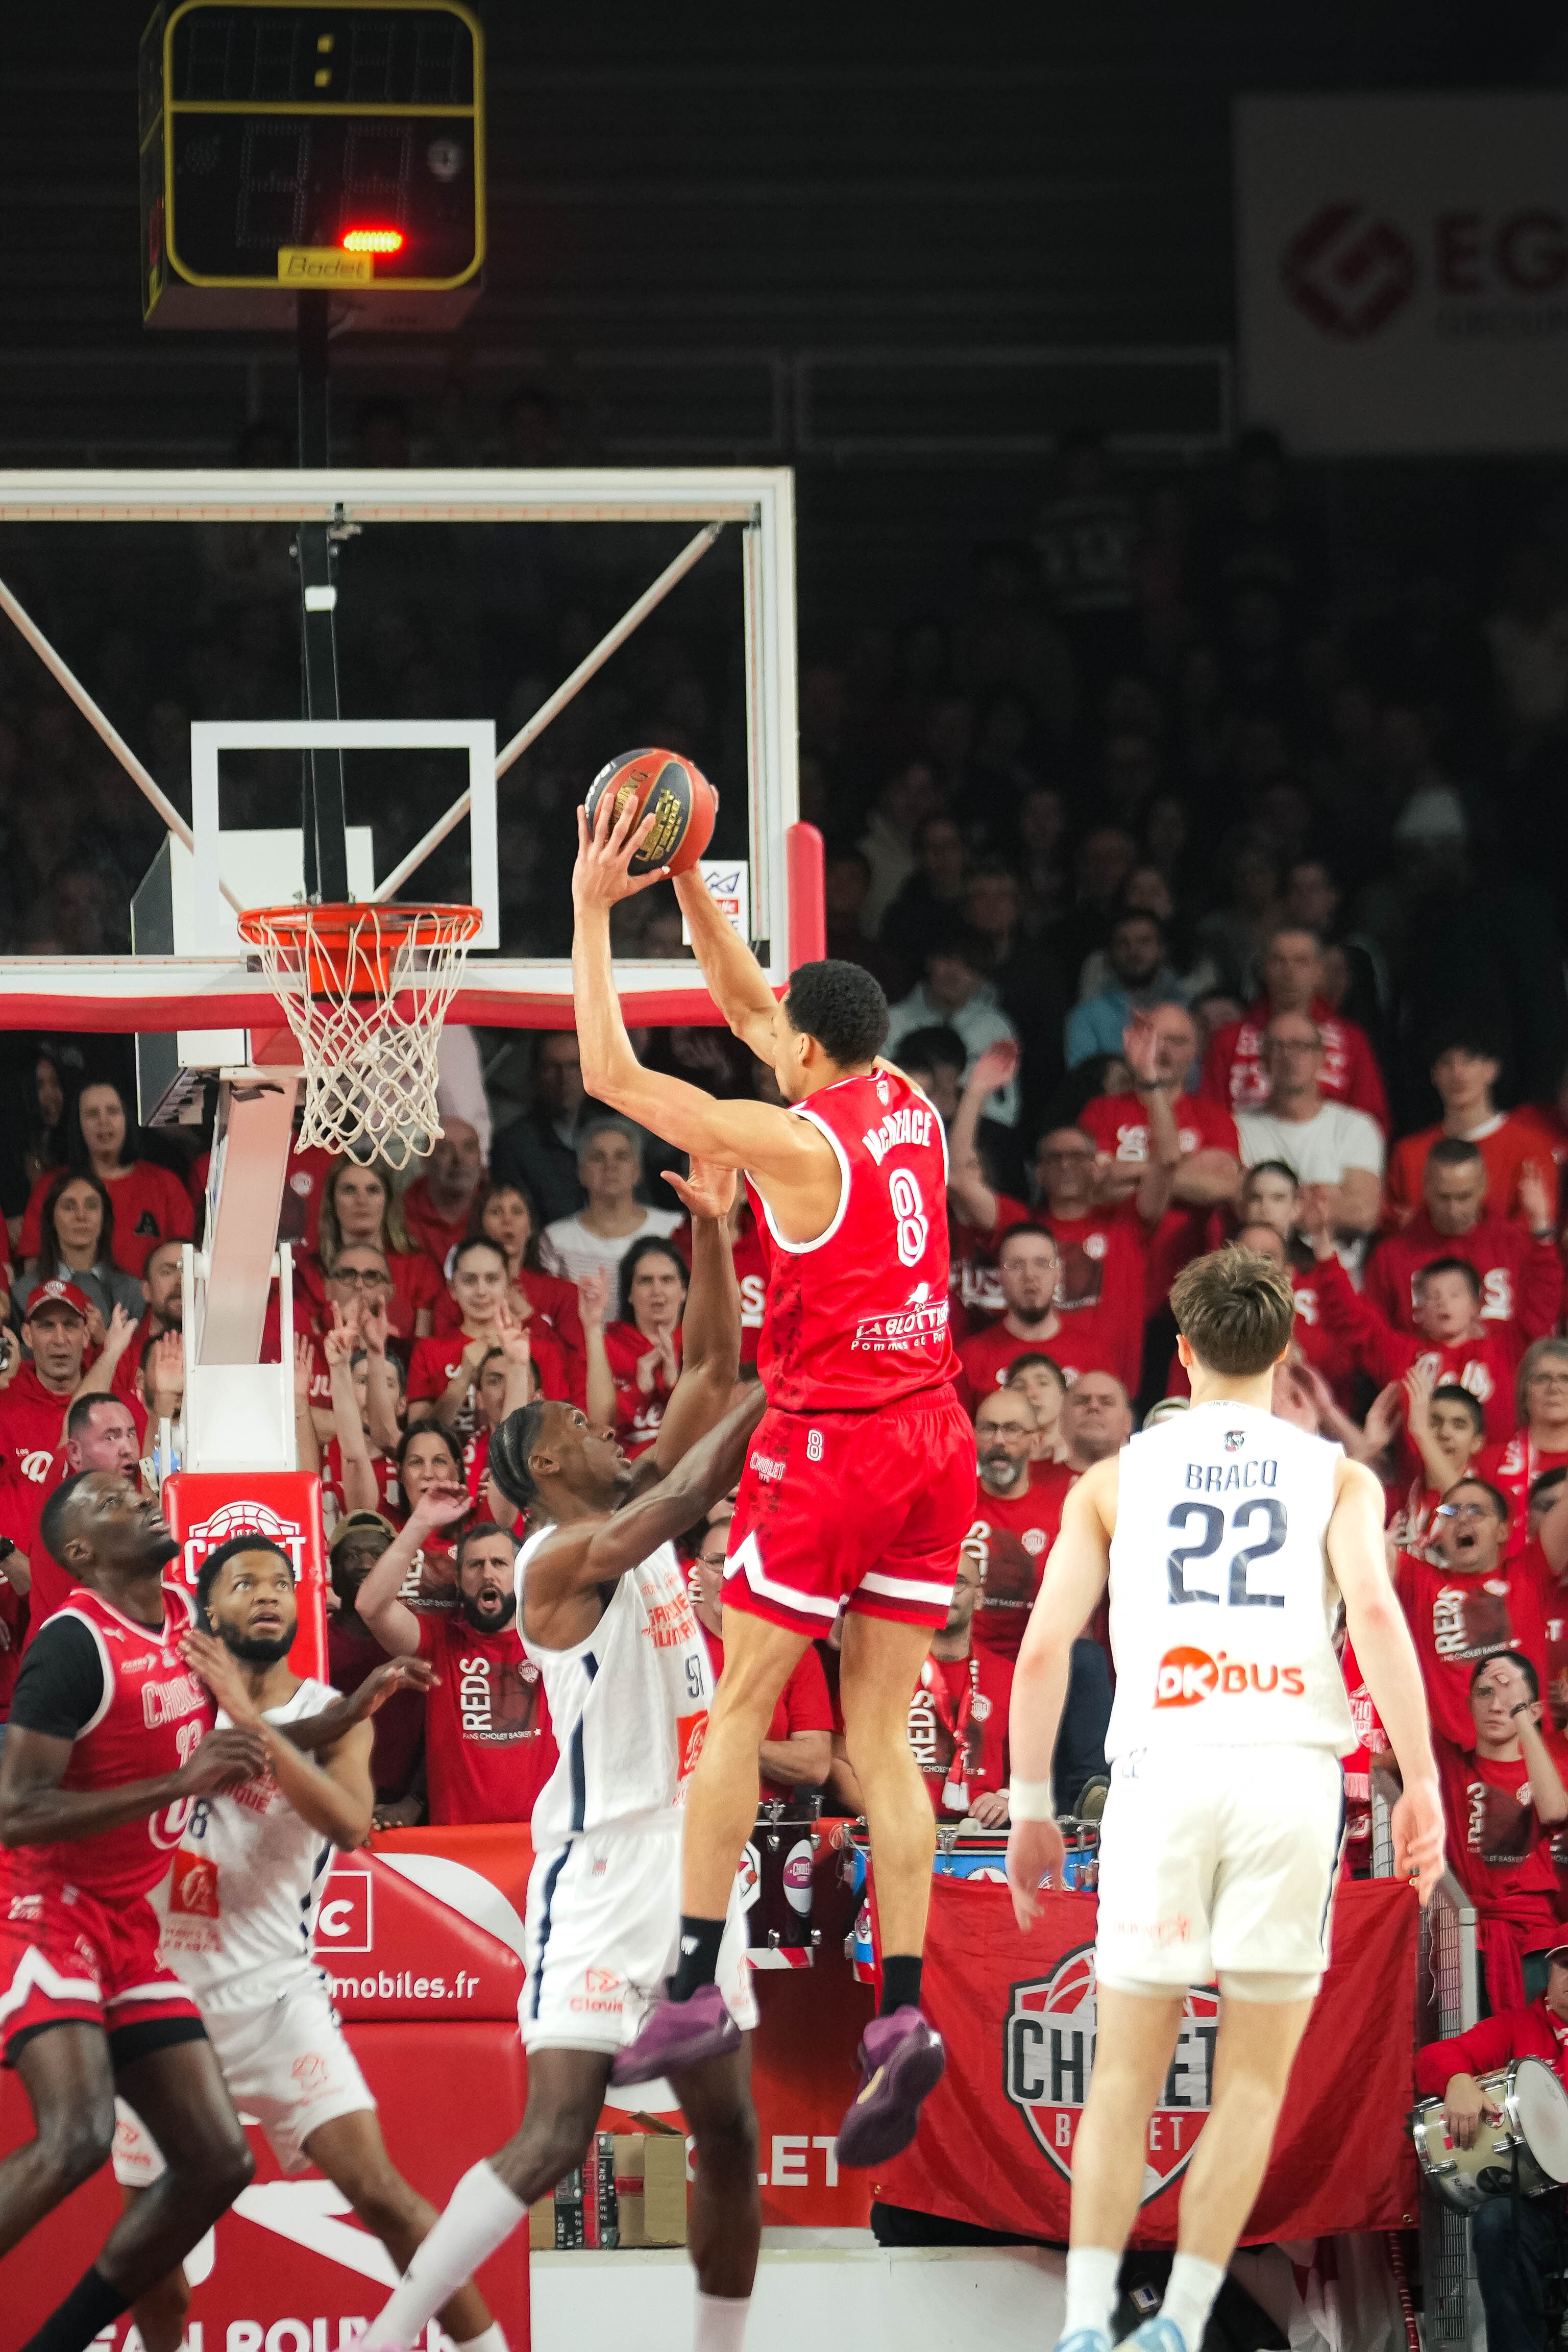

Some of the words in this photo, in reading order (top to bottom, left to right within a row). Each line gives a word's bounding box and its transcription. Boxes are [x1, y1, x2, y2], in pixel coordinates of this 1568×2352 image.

[889, 1168, 928, 1267] 8
[851, 1340, 908, 1351] Pommes
[914, 1334, 925, 1348] et
[750, 1452, 786, 1480] CHOLET
[806, 1429, 823, 1462] 8
[1185, 1459, 1278, 1492] BRACQ
[1167, 1498, 1287, 1608] 22
[459, 1657, 492, 1731] REDS
[906, 1689, 937, 1765] REDS
